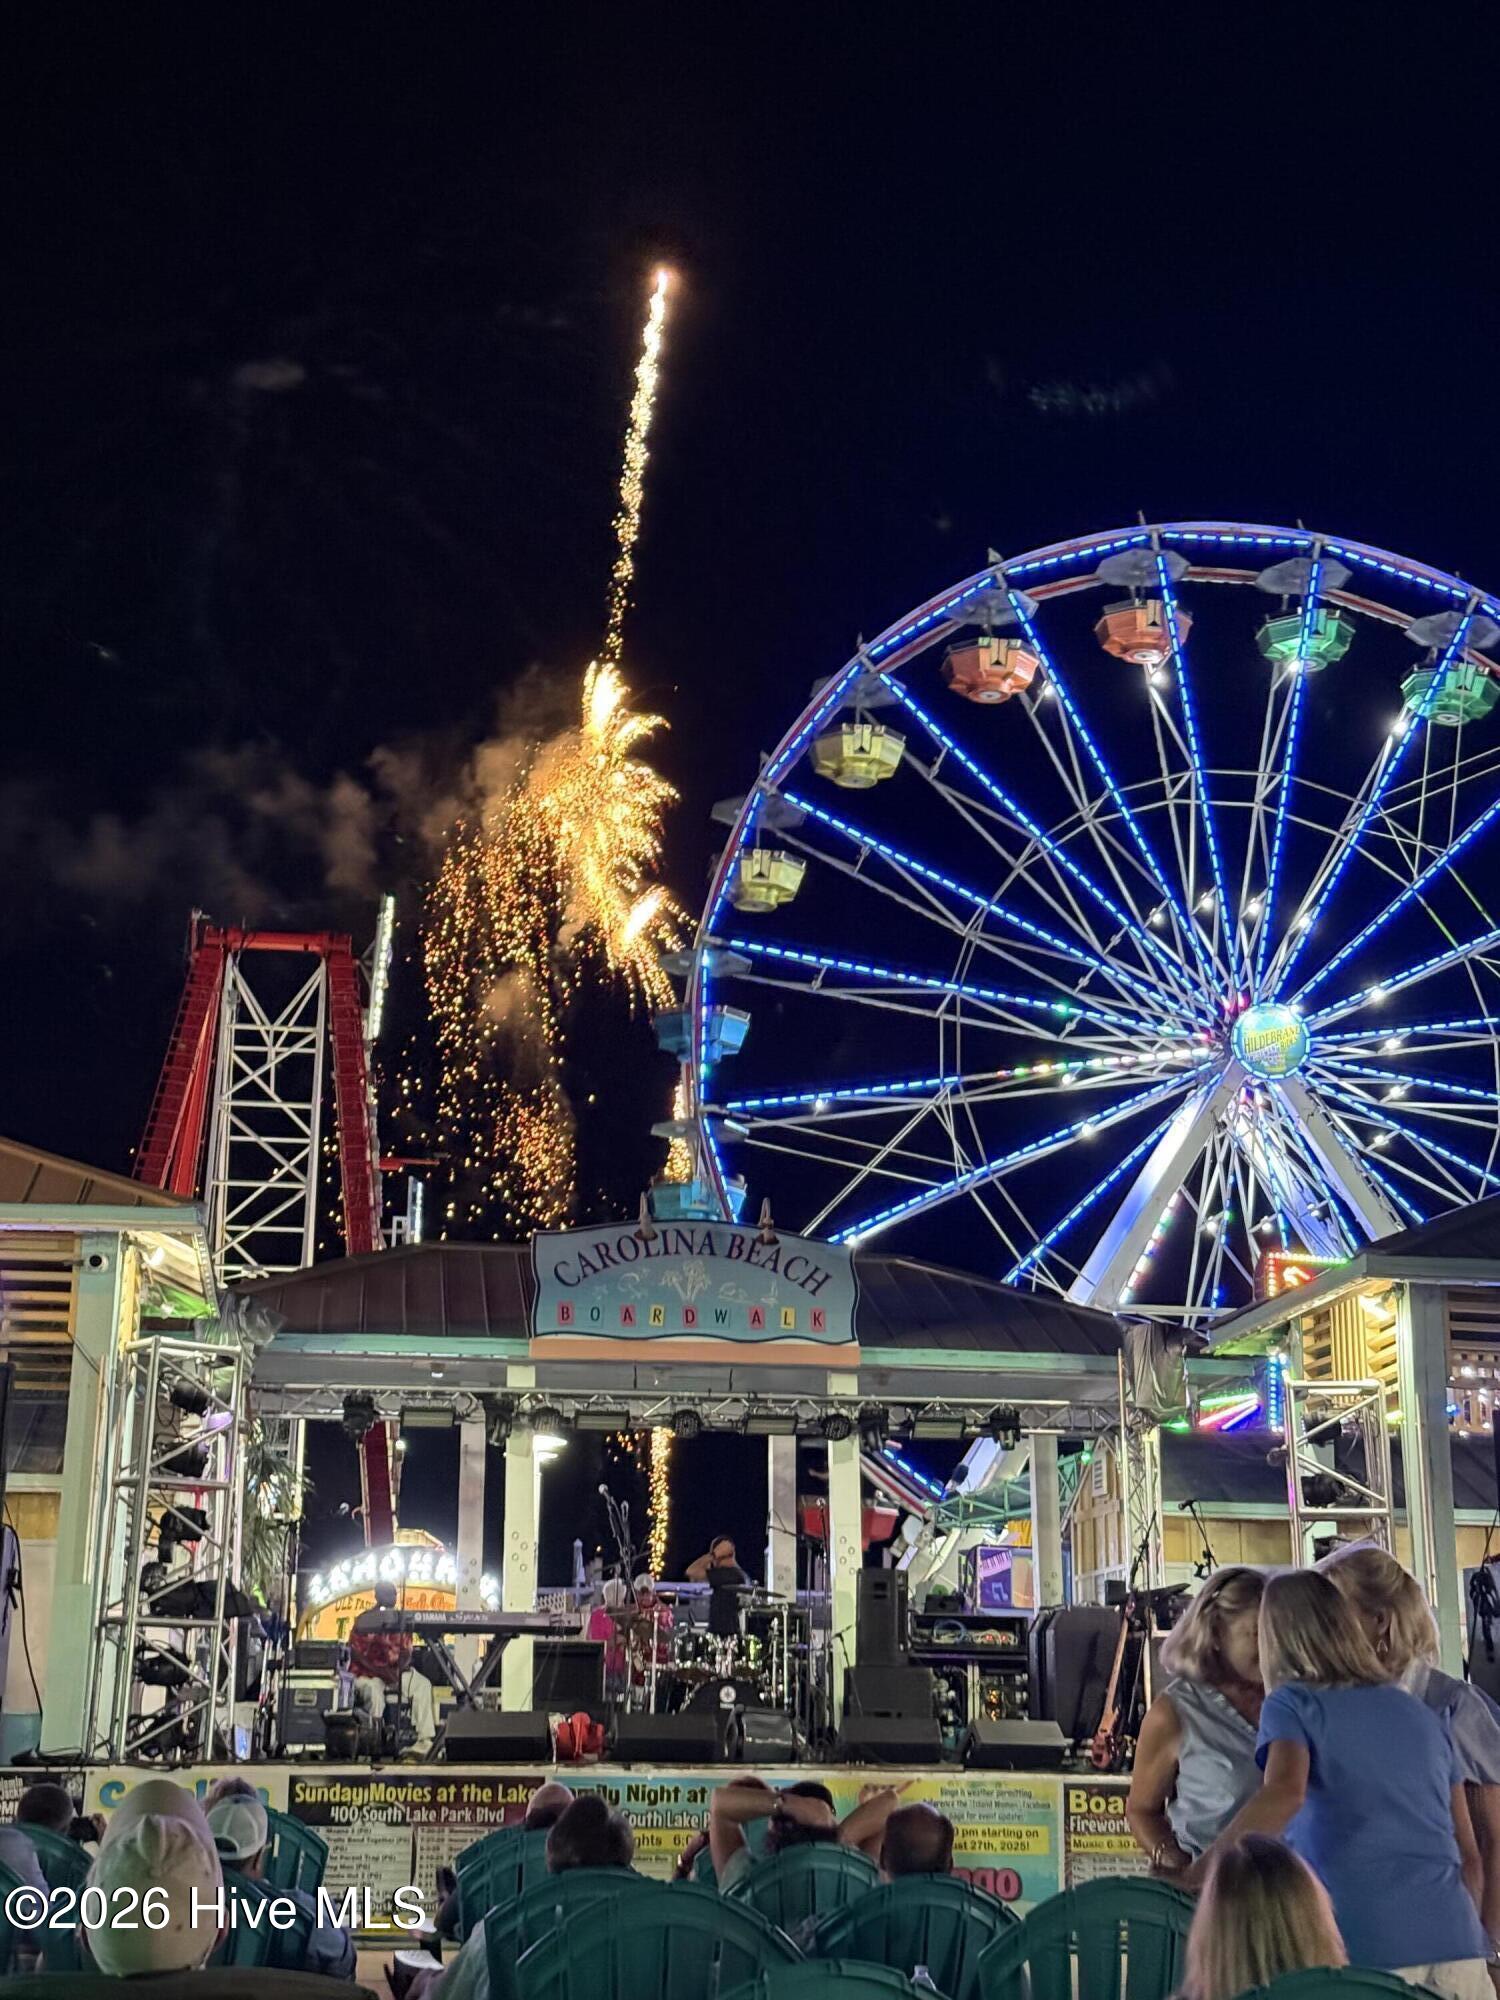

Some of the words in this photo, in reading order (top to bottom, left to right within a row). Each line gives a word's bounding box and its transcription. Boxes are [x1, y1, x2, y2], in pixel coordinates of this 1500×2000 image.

[553, 1228, 717, 1288] CAROLINA
[725, 1231, 833, 1298] BEACH
[559, 1304, 825, 1330] BOARDWALK
[295, 1783, 365, 1806] Sunday
[369, 1783, 432, 1803] Movies
[436, 1784, 457, 1803] at
[462, 1784, 493, 1803] the
[626, 1783, 681, 1806] Night
[687, 1785, 707, 1803] at
[330, 1806, 358, 1823] 400
[362, 1806, 401, 1823] South
[405, 1806, 437, 1823] Lake
[440, 1806, 472, 1823] Park
[476, 1806, 505, 1823] Blvd
[621, 1810, 662, 1827] South
[667, 1810, 699, 1828] Lake
[1069, 1815, 1131, 1833] Firework
[961, 1829, 979, 1839] pm
[981, 1827, 1023, 1840] starting
[1025, 1829, 1039, 1839] on
[1000, 1840, 1030, 1851] 2025!
